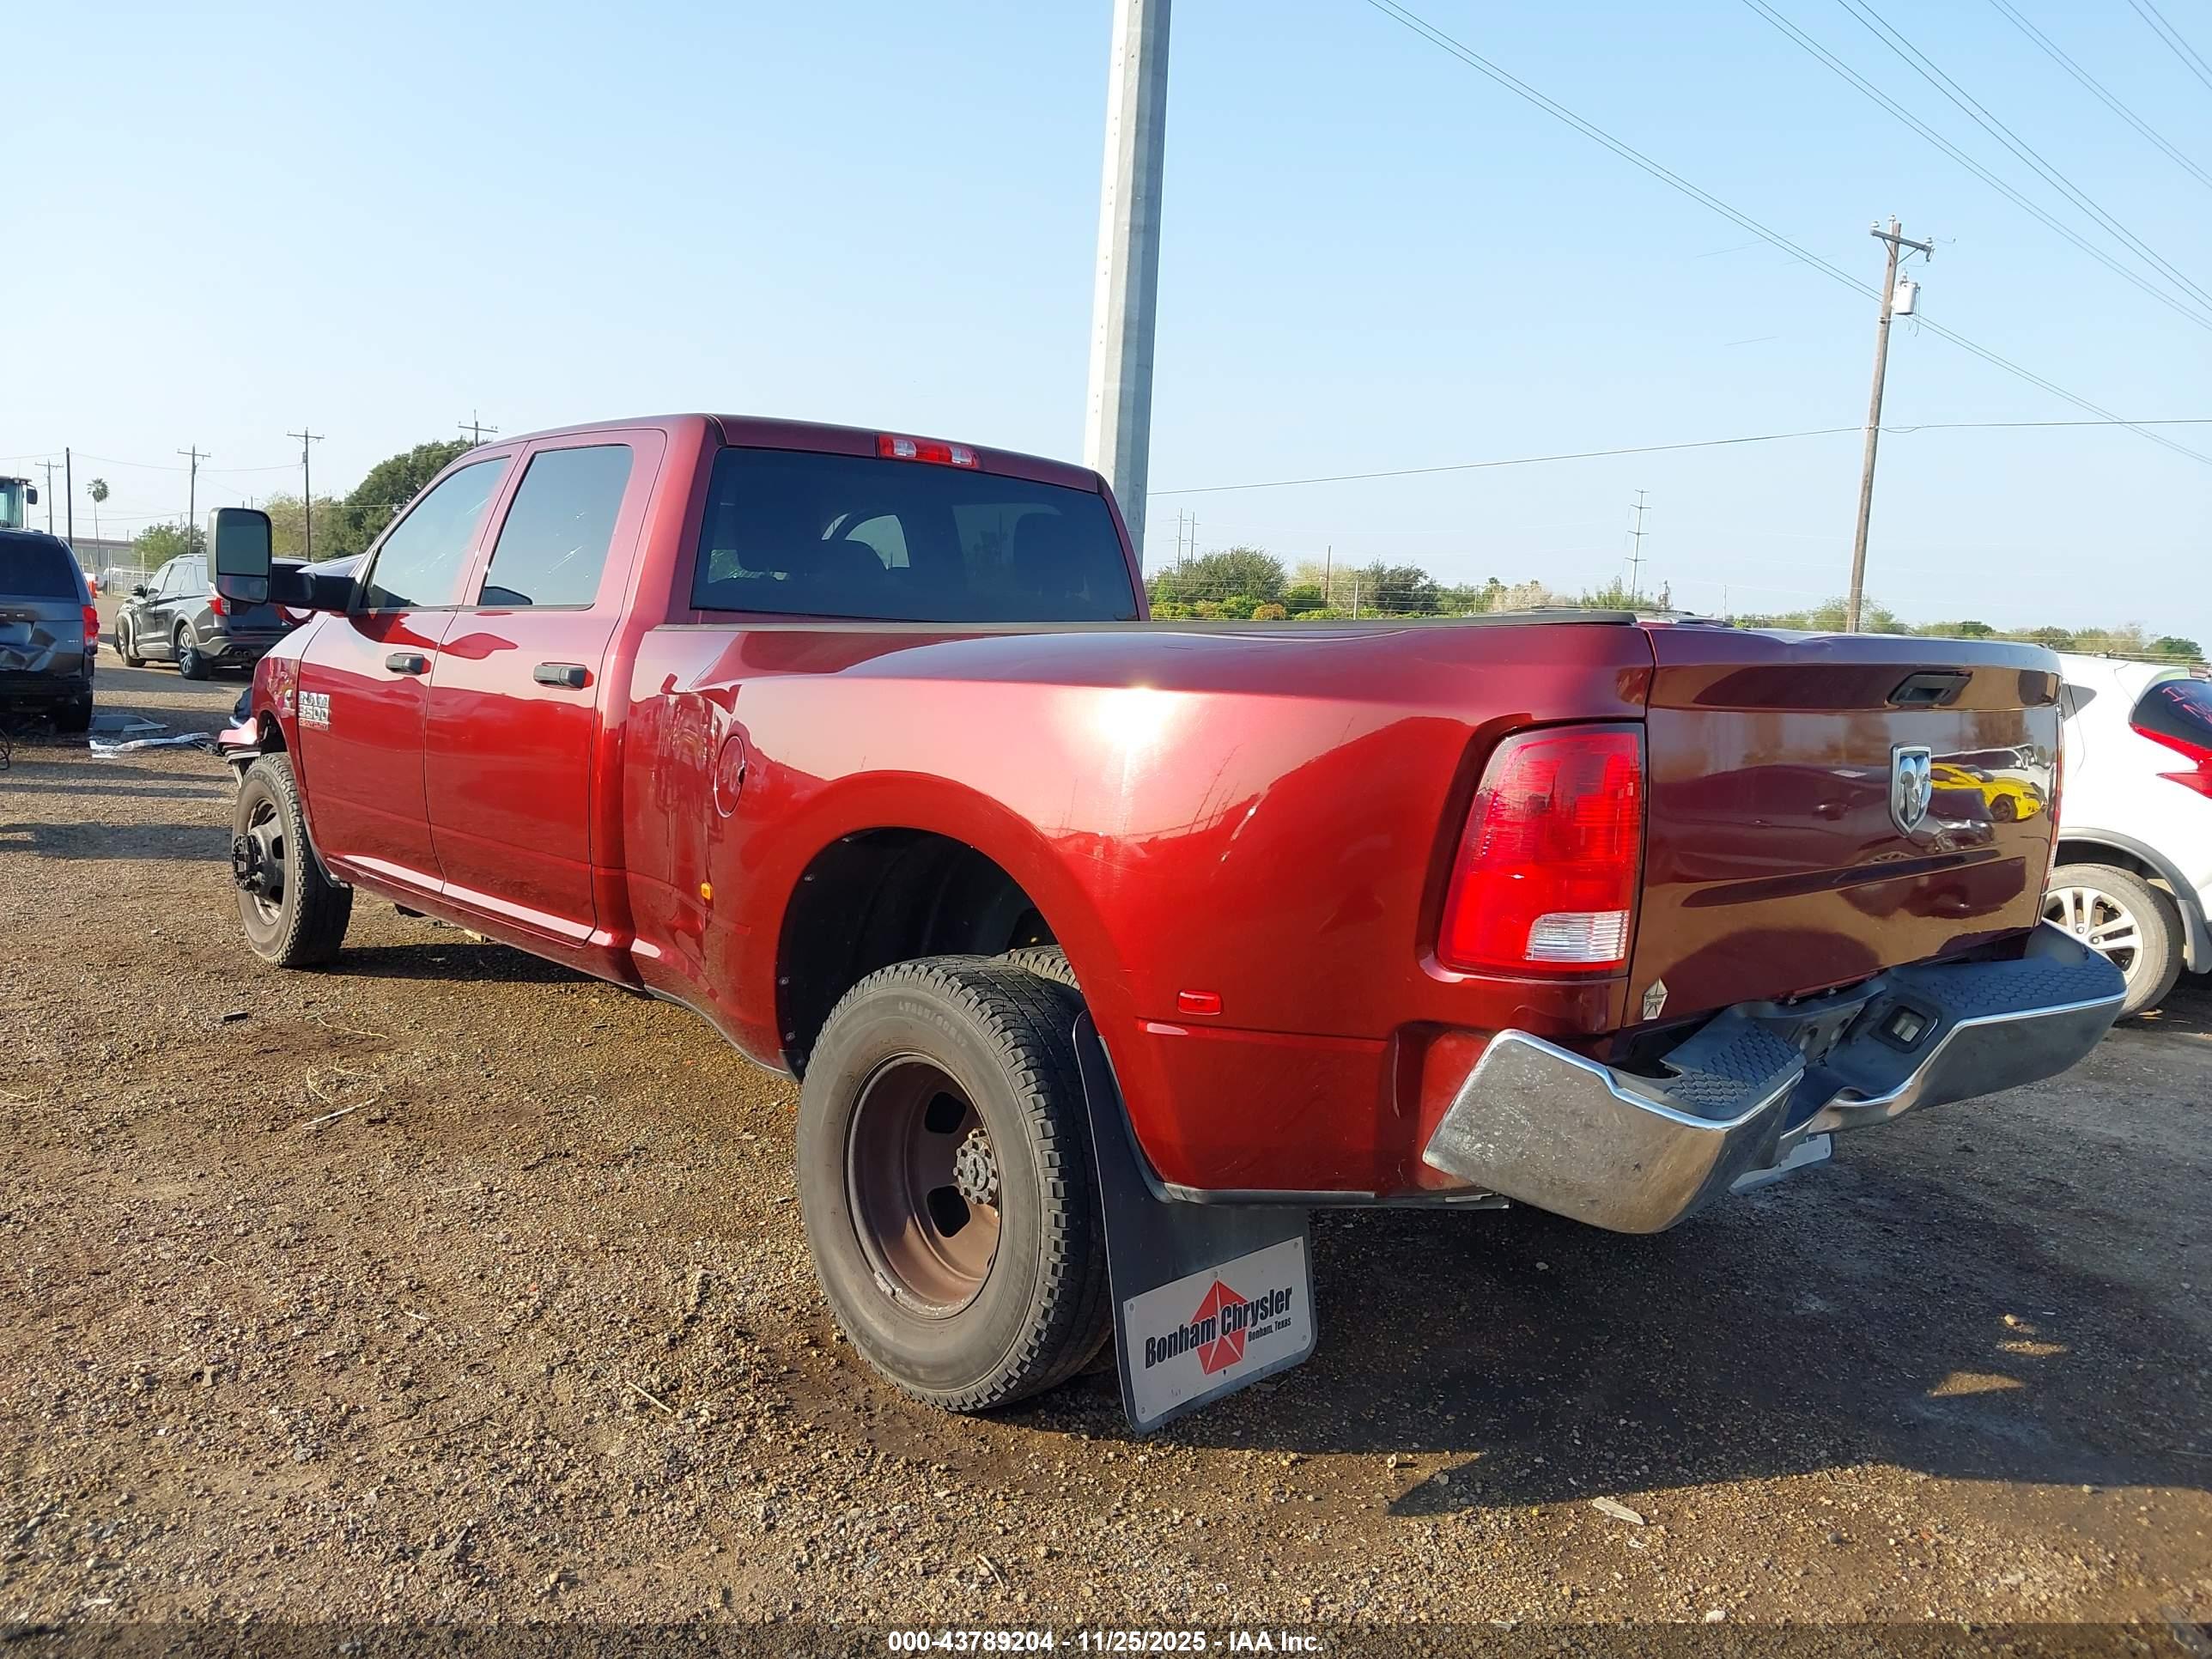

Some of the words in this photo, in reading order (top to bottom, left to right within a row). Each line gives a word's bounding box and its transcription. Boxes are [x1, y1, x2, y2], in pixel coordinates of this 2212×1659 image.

[298, 690, 330, 708] RAM
[298, 704, 329, 722] 3500
[1145, 1315, 1217, 1370] Bonham
[1220, 1286, 1292, 1335] Chrysler
[1274, 1316, 1291, 1332] Texas
